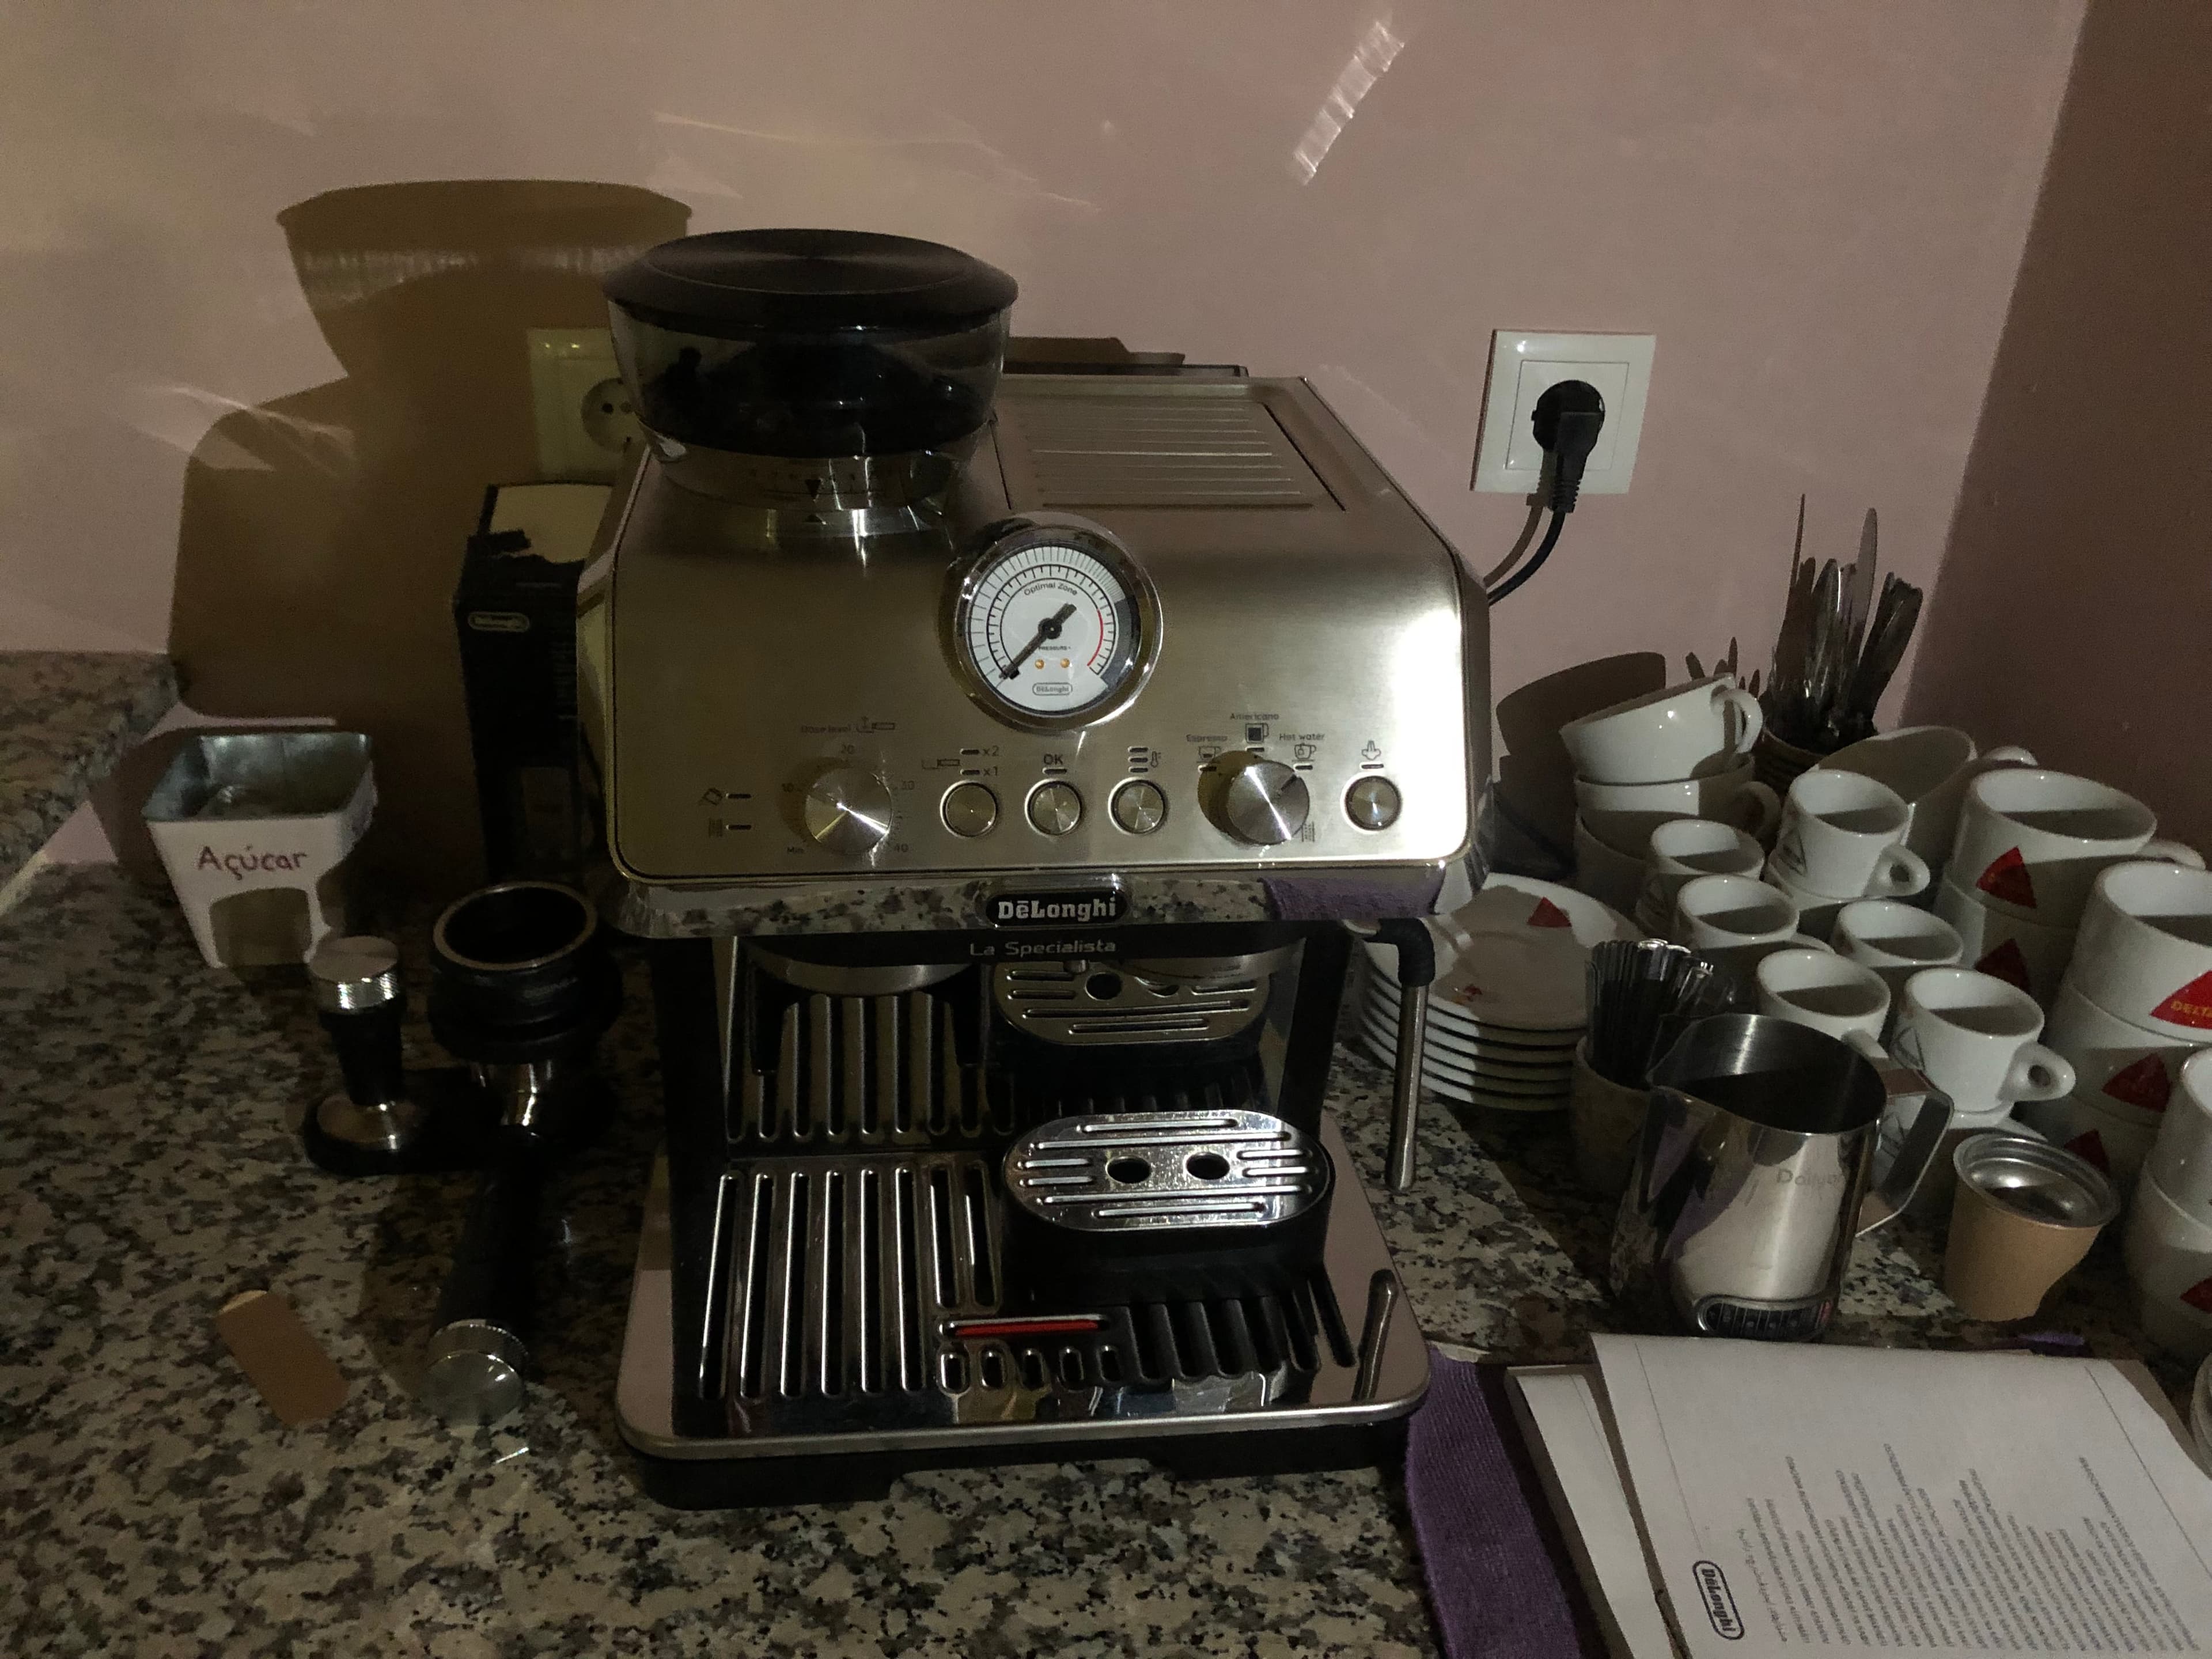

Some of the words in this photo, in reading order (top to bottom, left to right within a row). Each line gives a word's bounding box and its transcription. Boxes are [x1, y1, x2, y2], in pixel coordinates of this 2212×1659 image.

[1024, 582, 1056, 596] Optimal
[1058, 582, 1078, 596] Zone
[1230, 713, 1279, 721] Americano
[1279, 733, 1295, 741] Hot
[1297, 733, 1324, 741] water
[982, 746, 999, 757] x2
[1043, 753, 1063, 765] OK
[983, 766, 999, 777] x1
[198, 843, 308, 881] Açúcar
[969, 943, 996, 956] La
[1005, 939, 1117, 958] Specialista
